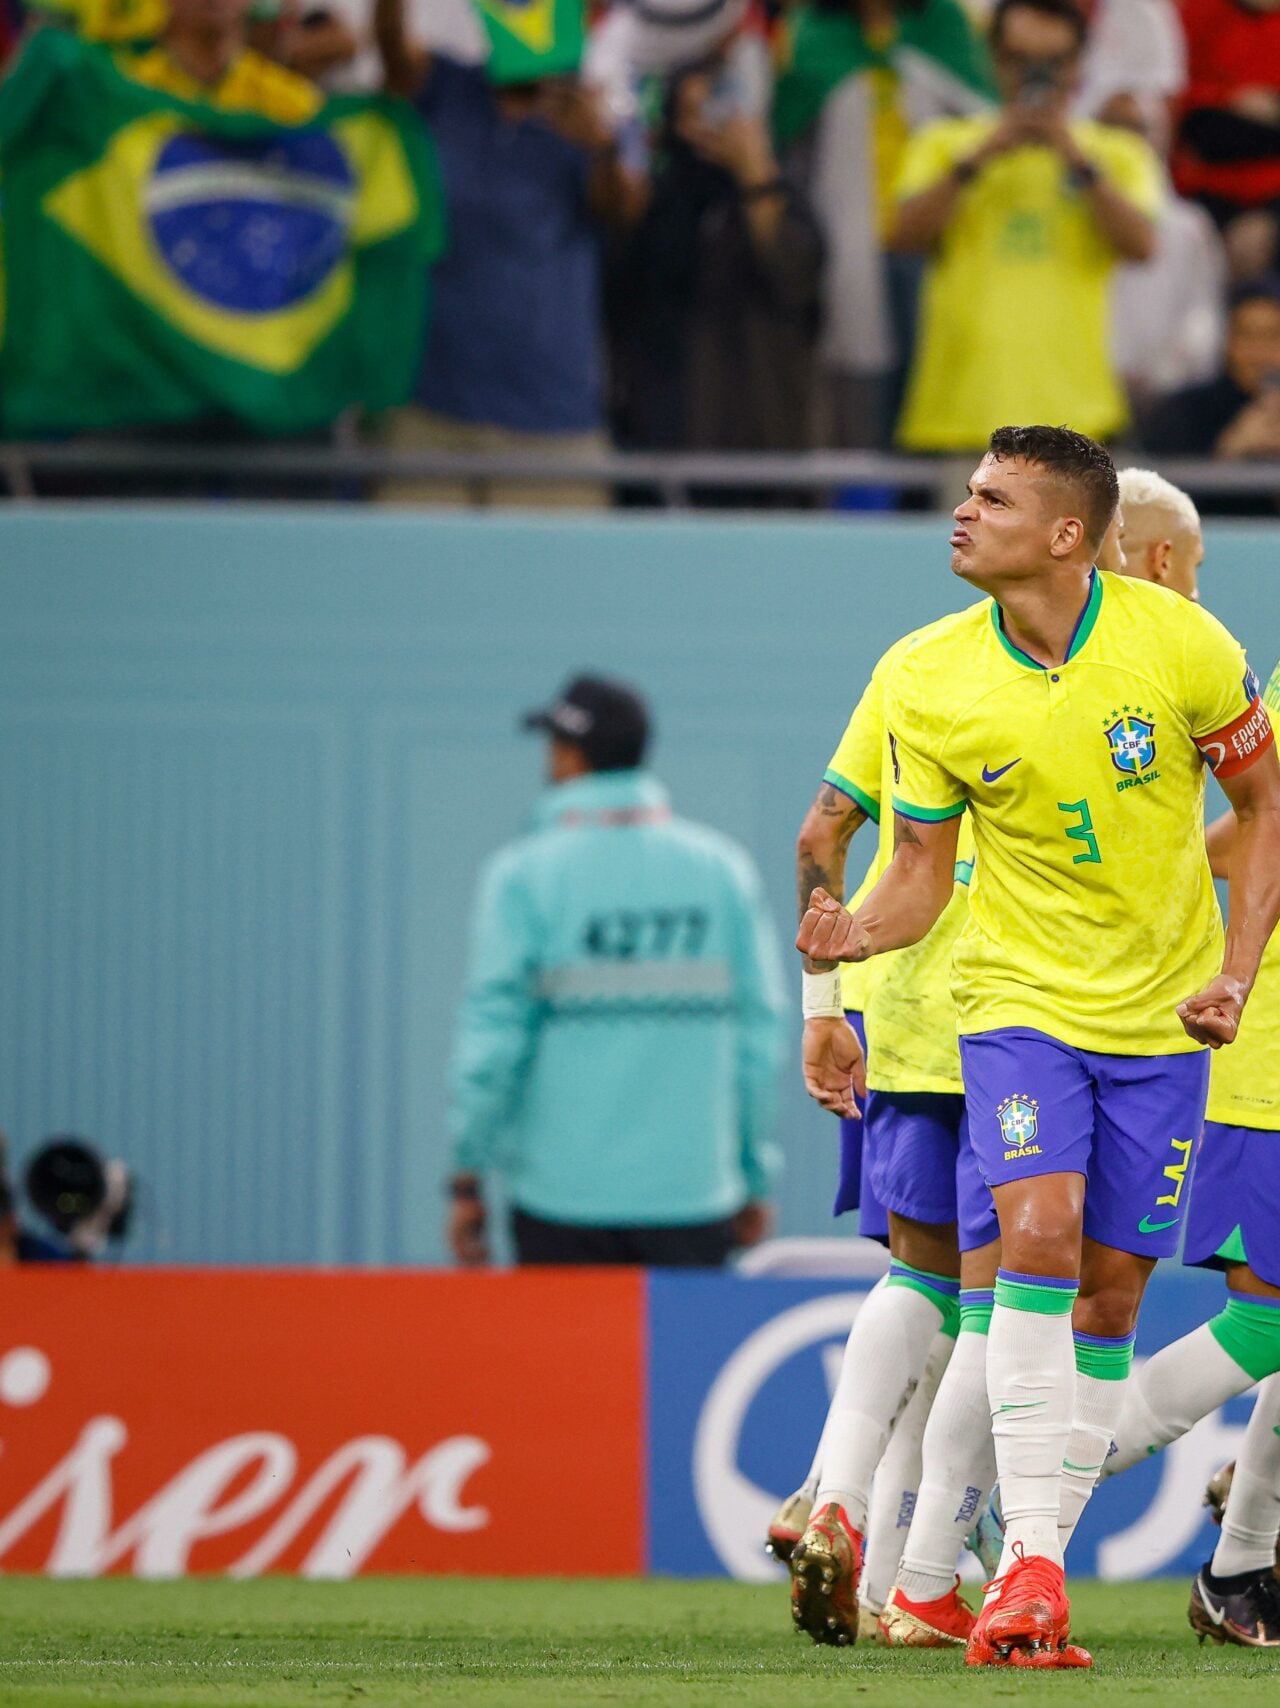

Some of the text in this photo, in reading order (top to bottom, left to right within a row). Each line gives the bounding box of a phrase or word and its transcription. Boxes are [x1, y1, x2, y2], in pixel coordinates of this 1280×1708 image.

[1122, 739, 1141, 750] CBF
[1237, 736, 1259, 760] FOR
[1116, 770, 1161, 793] BRASIL
[1057, 798, 1103, 865] 3
[1010, 1118, 1026, 1127] CBF
[1004, 1144, 1043, 1162] BRASIL
[1155, 1137, 1194, 1208] 3
[0, 1346, 493, 1580] ser
[954, 1486, 982, 1523] BRASIL
